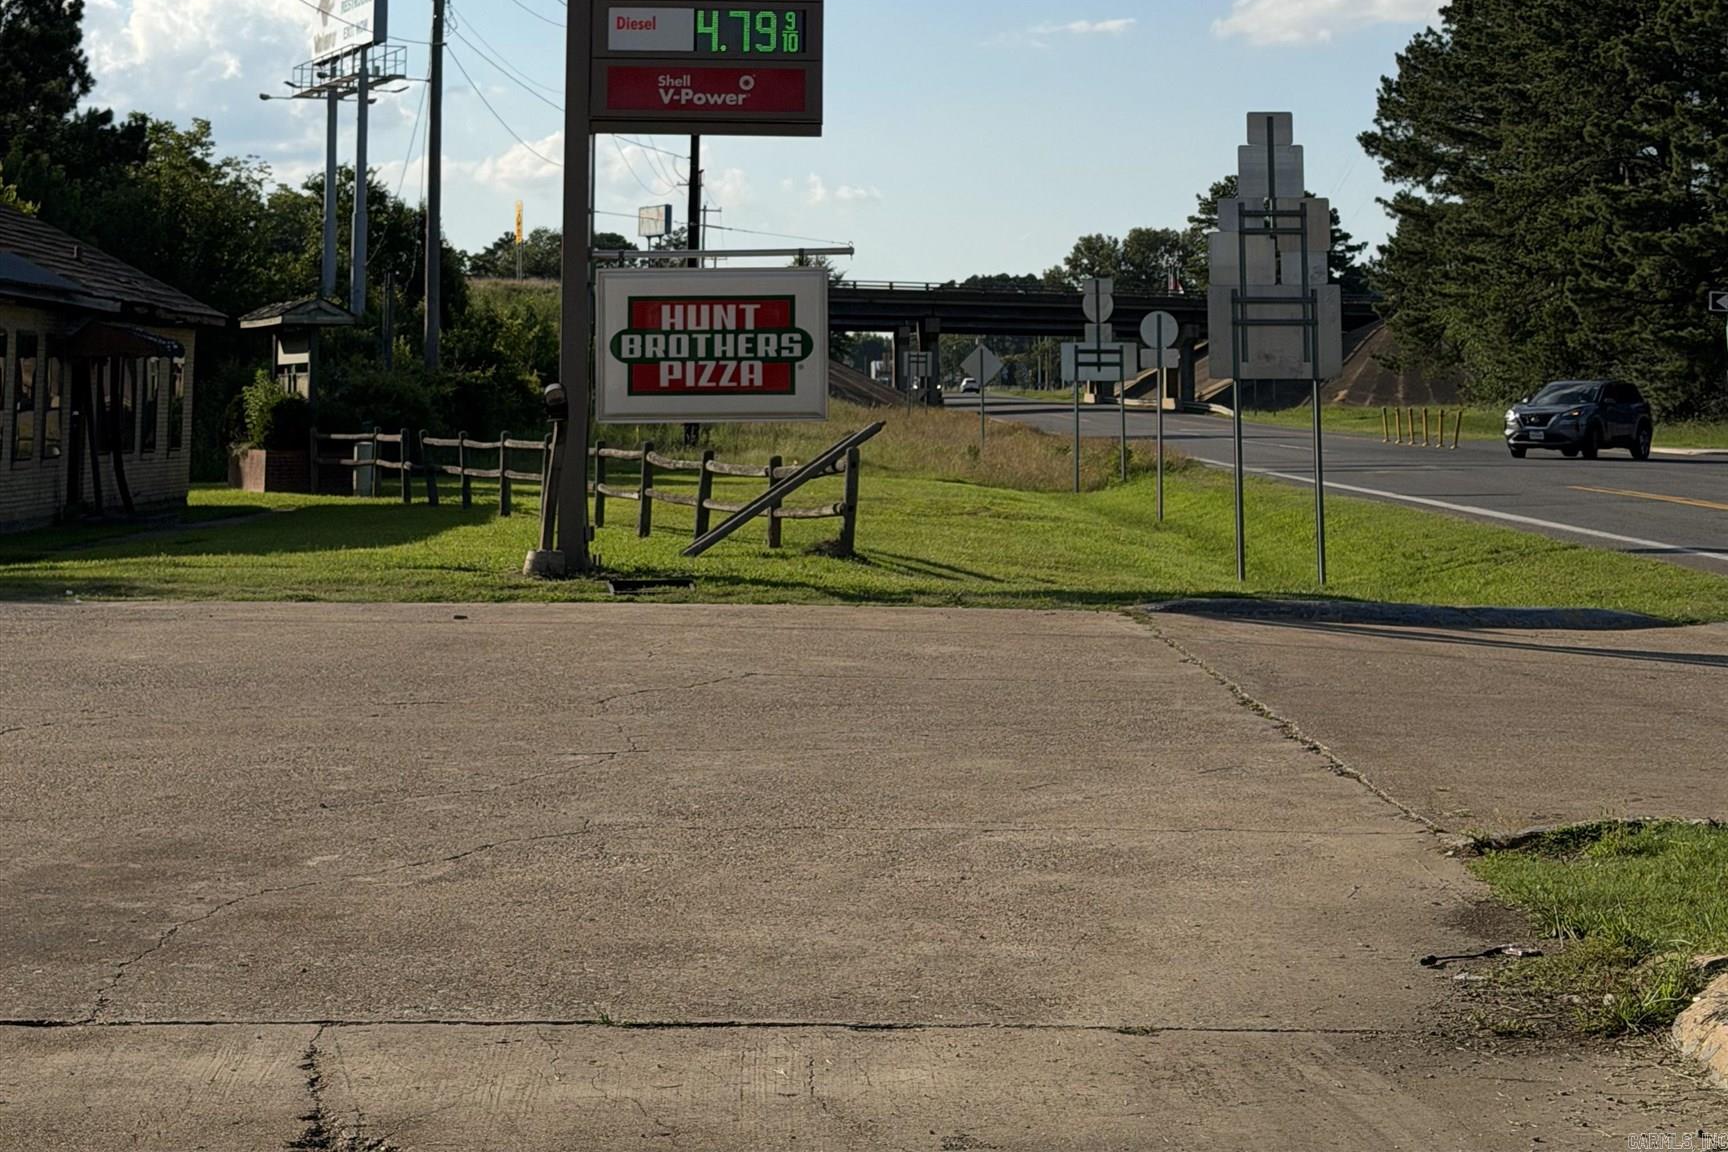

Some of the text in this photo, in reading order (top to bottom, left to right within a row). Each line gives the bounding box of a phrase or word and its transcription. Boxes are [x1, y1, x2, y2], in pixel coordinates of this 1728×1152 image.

[616, 16, 657, 31] Diesel
[697, 10, 778, 53] 4.79
[658, 74, 691, 87] Shell
[659, 88, 746, 105] V-Power
[661, 304, 761, 330] HUNT
[621, 333, 803, 358] BROTHERS
[659, 360, 764, 387] PIZZA
